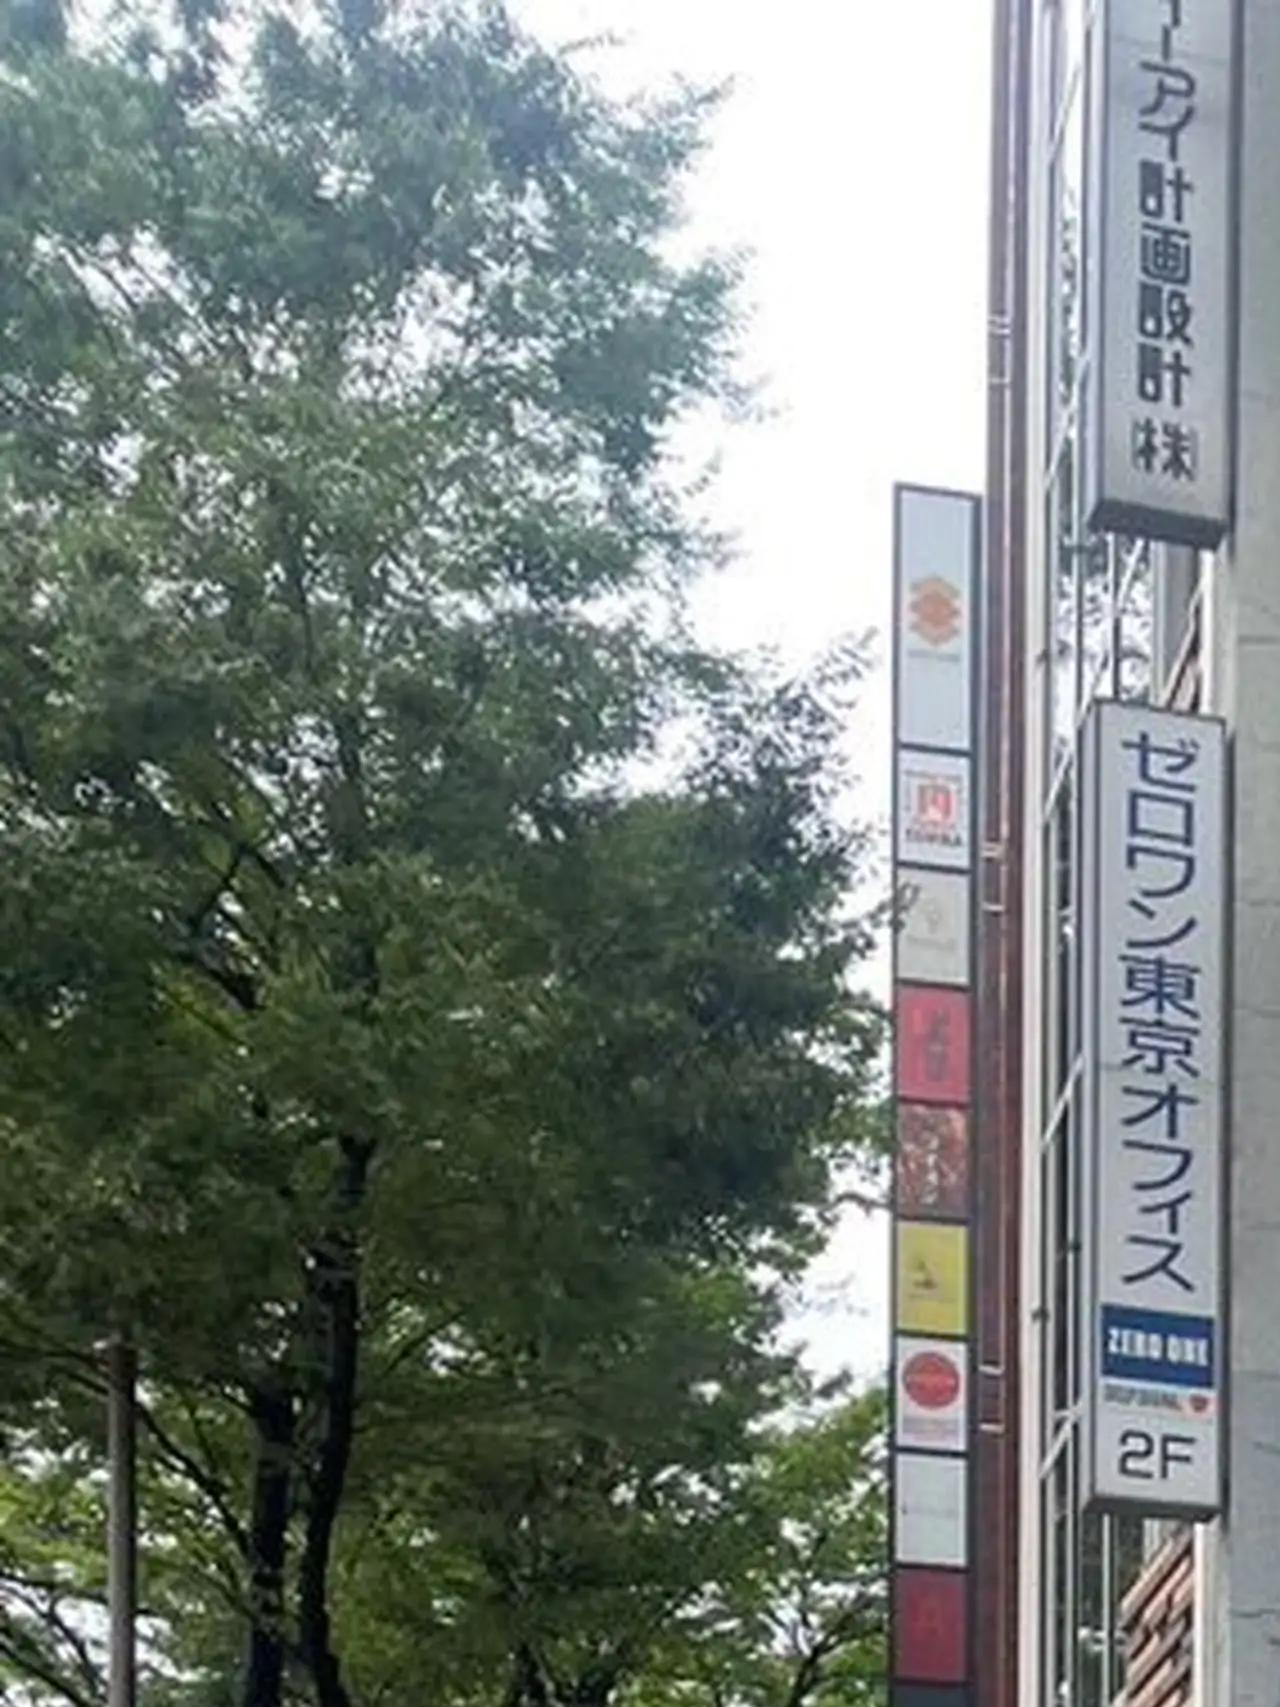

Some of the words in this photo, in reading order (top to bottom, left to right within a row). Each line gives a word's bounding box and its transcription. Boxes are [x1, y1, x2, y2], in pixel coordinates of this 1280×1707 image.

[1117, 730, 1203, 1294] ゼロワン東京オフィス
[1117, 1429, 1198, 1481] 2F
